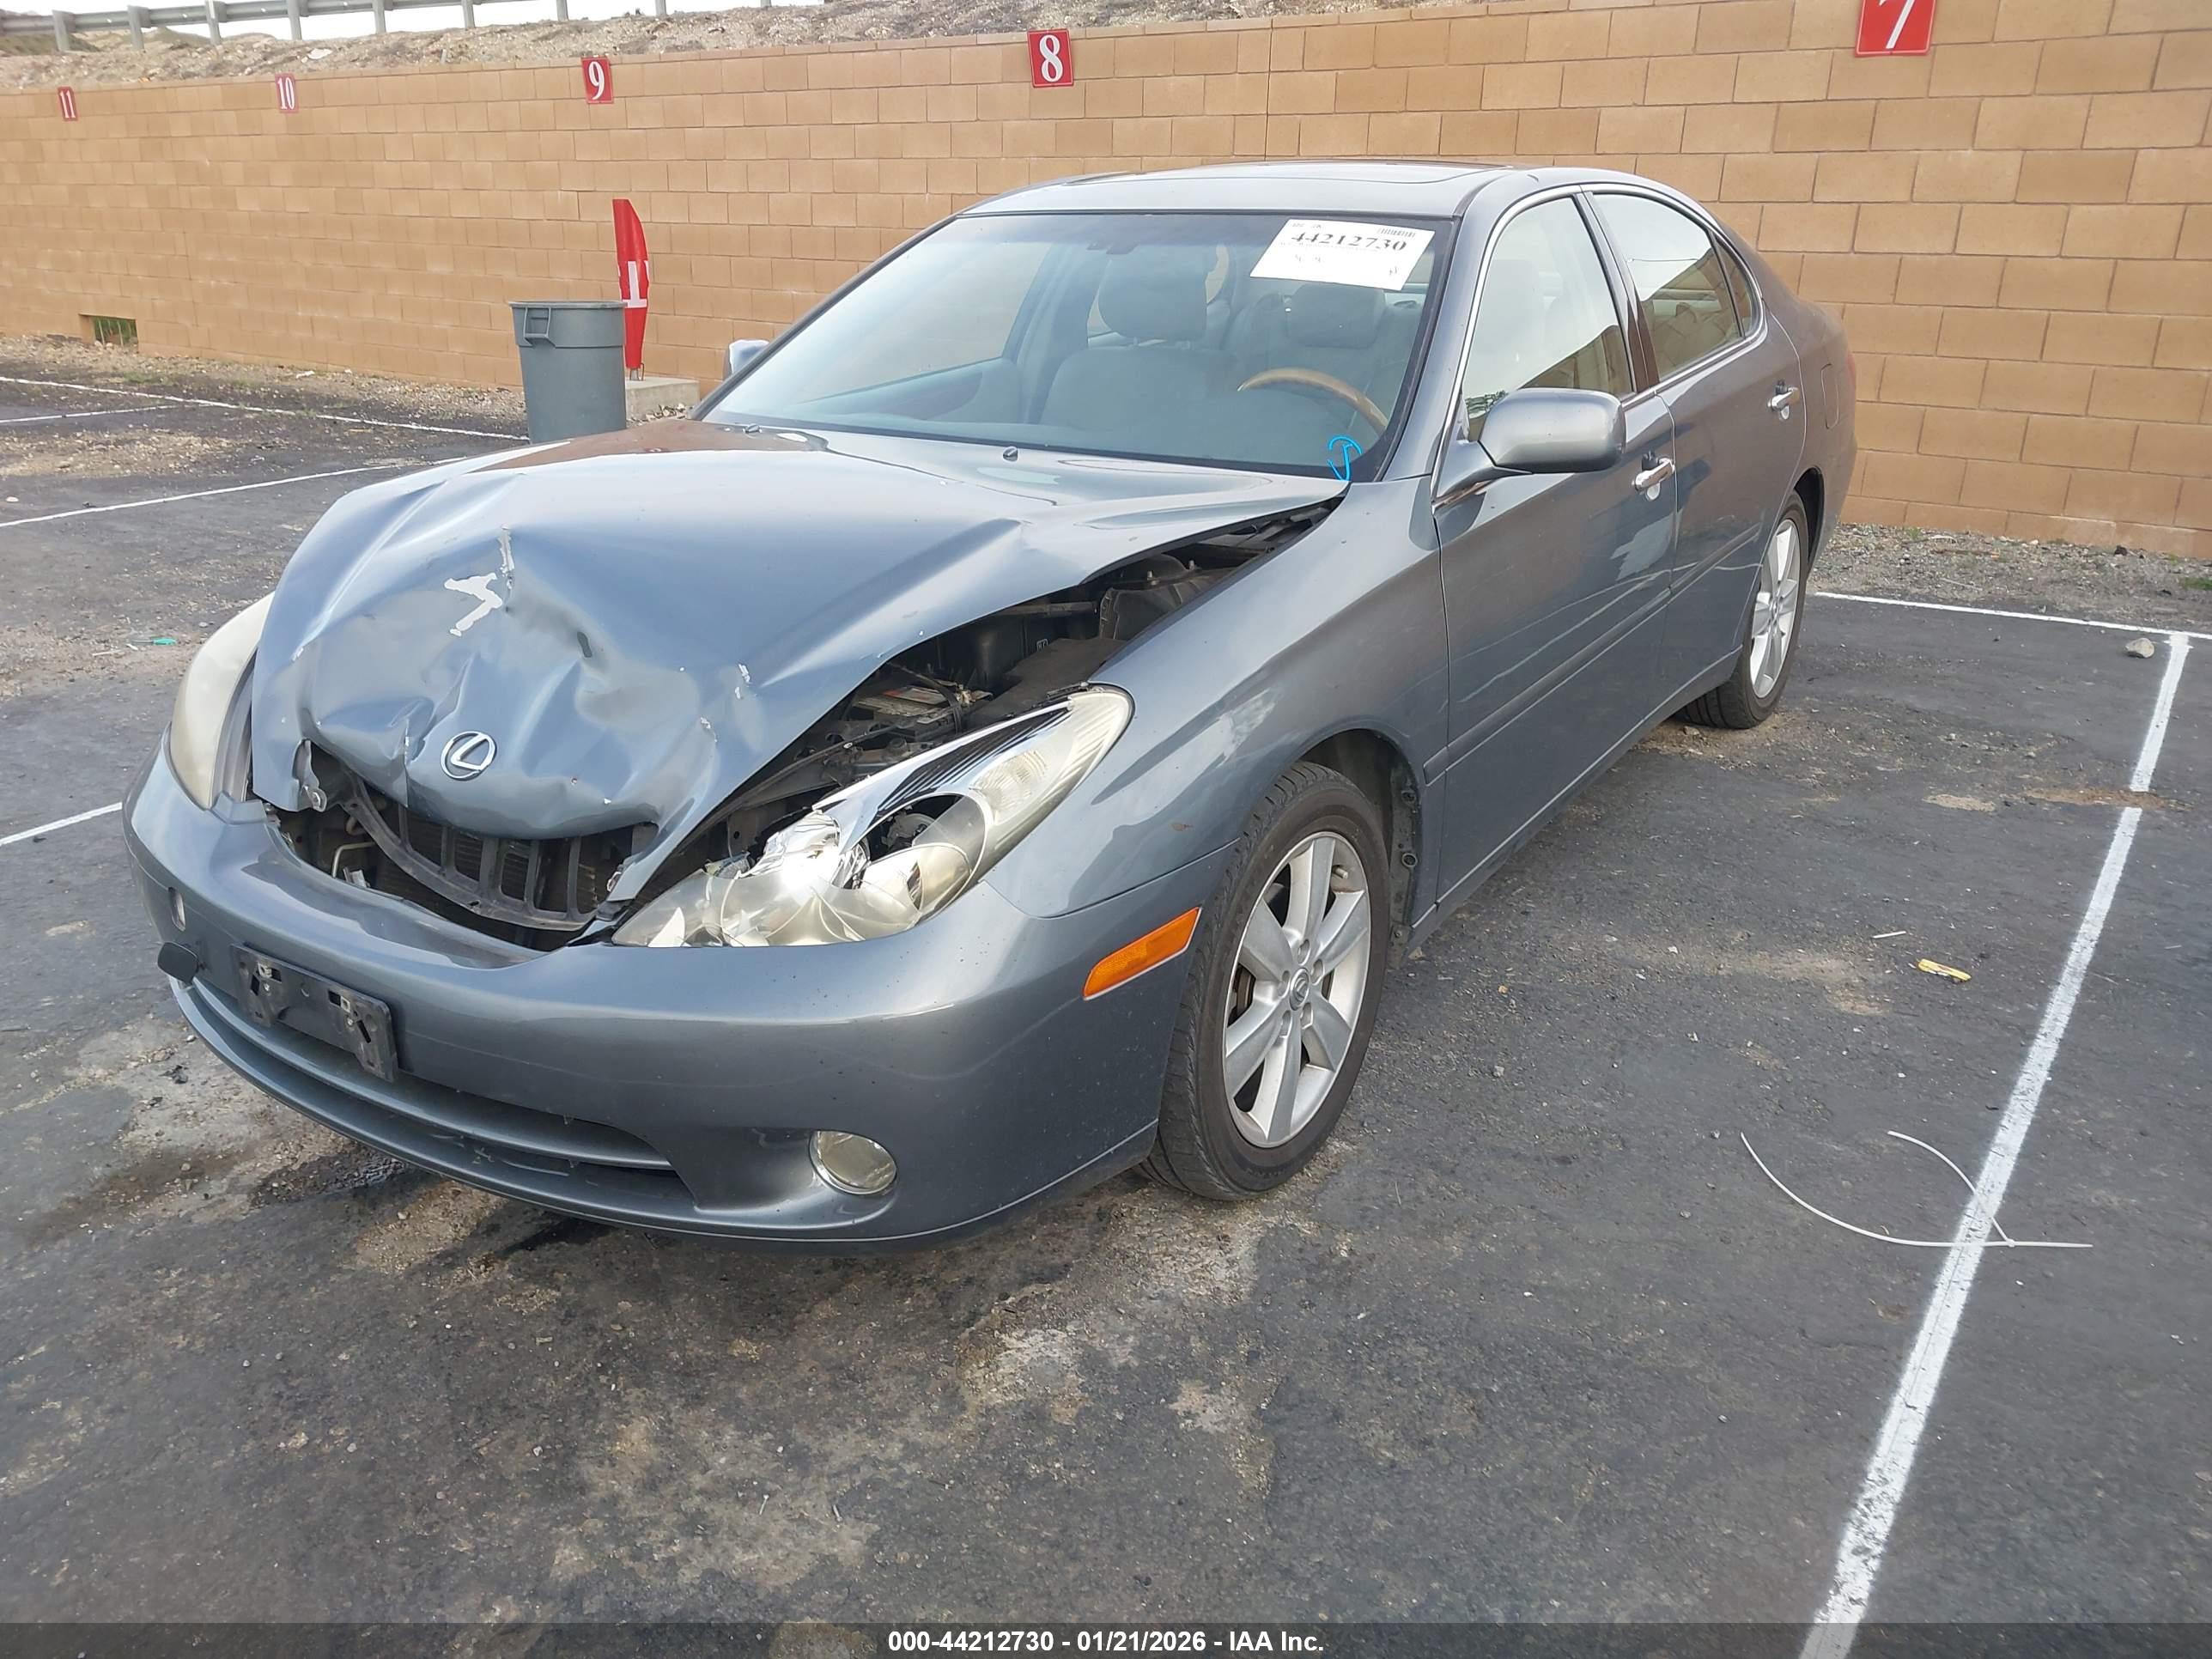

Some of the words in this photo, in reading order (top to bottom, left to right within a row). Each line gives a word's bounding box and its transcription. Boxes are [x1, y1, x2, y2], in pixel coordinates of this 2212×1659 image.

[1879, 0, 1916, 49] 7
[1039, 34, 1063, 82] 8
[277, 77, 295, 110] 10
[588, 61, 605, 100] 9
[60, 89, 76, 118] 11
[1291, 231, 1407, 251] 44212730
